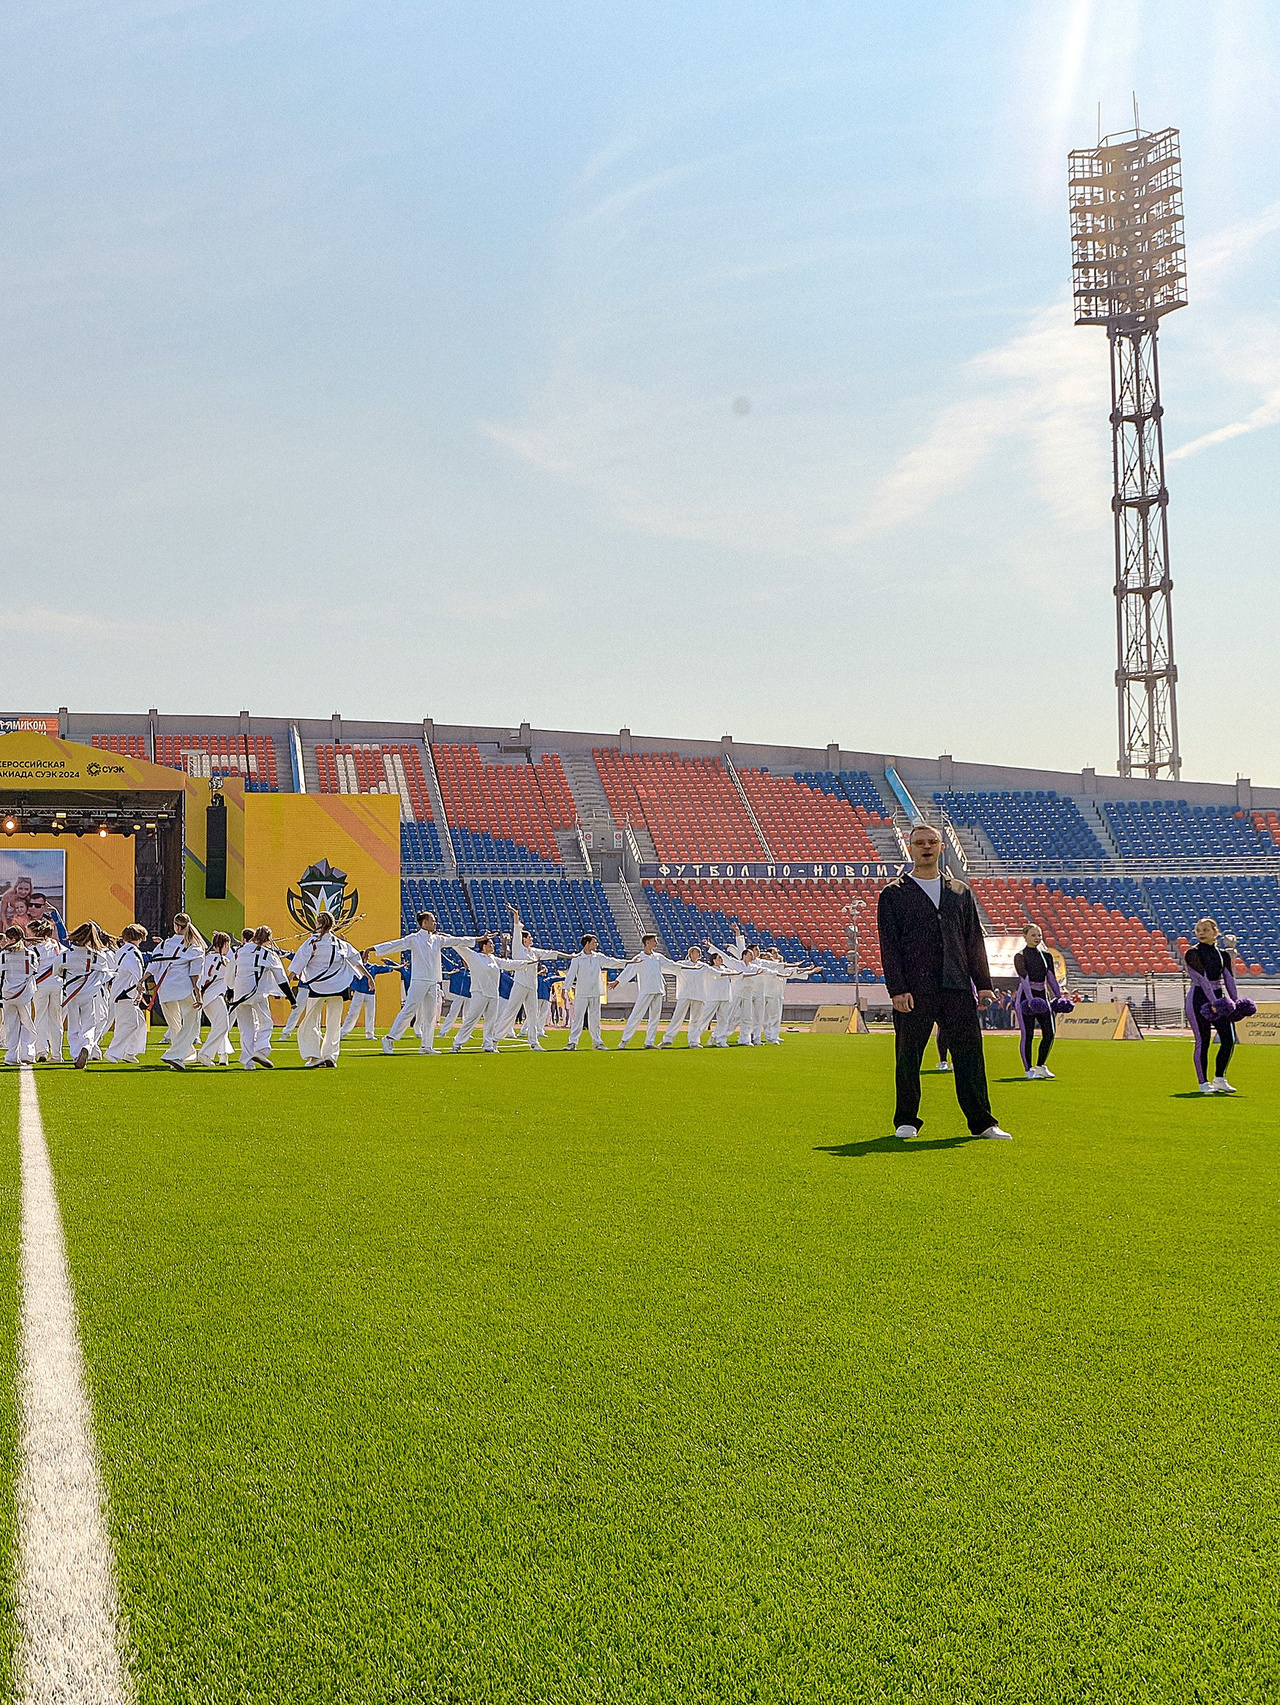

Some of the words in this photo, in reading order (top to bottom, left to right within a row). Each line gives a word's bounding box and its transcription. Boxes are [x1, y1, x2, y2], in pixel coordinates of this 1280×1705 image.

[102, 765, 125, 773] СУЭК
[658, 863, 750, 877] ФУТБОЛ
[767, 863, 905, 877] ПО-НОВОМУ
